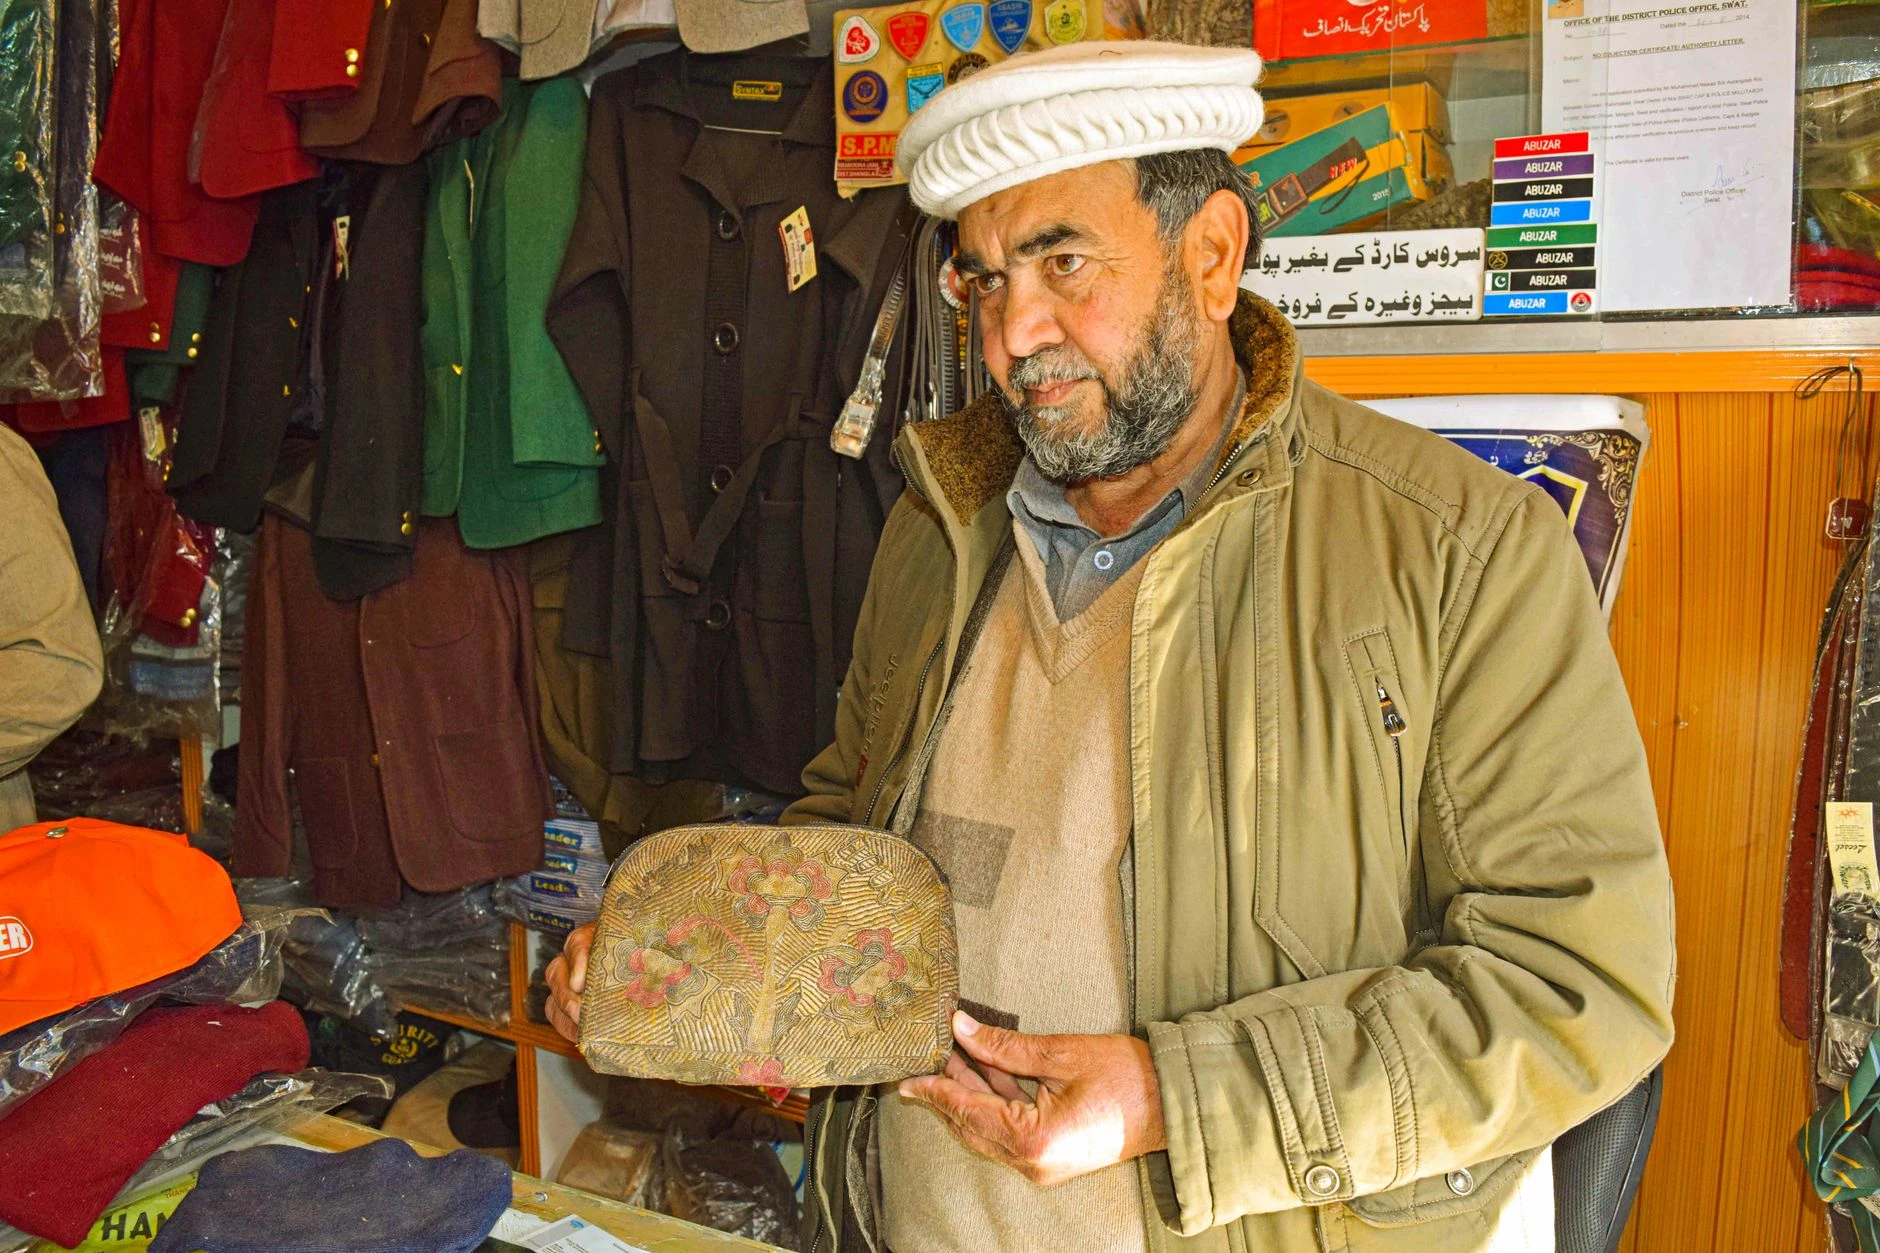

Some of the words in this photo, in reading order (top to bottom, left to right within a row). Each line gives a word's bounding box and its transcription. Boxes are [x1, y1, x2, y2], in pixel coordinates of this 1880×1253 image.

[1349, 6, 1390, 37] تحریک
[1384, 4, 1431, 33] پاکستان
[1564, 18, 1591, 27] OFFICE
[1592, 16, 1602, 24] OF
[1605, 14, 1620, 23] THE
[1622, 10, 1657, 21] DISTRICT
[1659, 7, 1687, 16] POLICE
[1688, 3, 1719, 13] OFFICE,
[1721, 0, 1748, 9] SWAT.
[1303, 17, 1349, 38] انصاف
[1603, 50, 1638, 58] OBJECTION
[1681, 41, 1718, 50] AUTHORITY
[1523, 139, 1561, 151] ABUZAR
[1328, 157, 1358, 179] NEW
[1524, 161, 1563, 173] ABUZAR
[1524, 183, 1563, 196] ABUZAR
[1681, 190, 1703, 198] District
[1704, 188, 1724, 196] Police
[1725, 187, 1746, 195] Officer
[1522, 207, 1560, 219] ABUZAR
[1519, 230, 1557, 242] ABUZAR
[1284, 246, 1329, 274] بغیر
[1333, 244, 1365, 273] کے
[1371, 238, 1410, 270] کارڈ
[1416, 245, 1481, 268] سروس
[1535, 252, 1574, 264] ABUZAR
[1529, 274, 1568, 286] ABUZAR
[1275, 291, 1322, 320] فروخ
[1327, 291, 1359, 320] کے
[1425, 291, 1474, 316] بیجز
[1508, 298, 1546, 309] ABUZAR
[544, 832, 579, 846] eader
[529, 912, 573, 929] Leader
